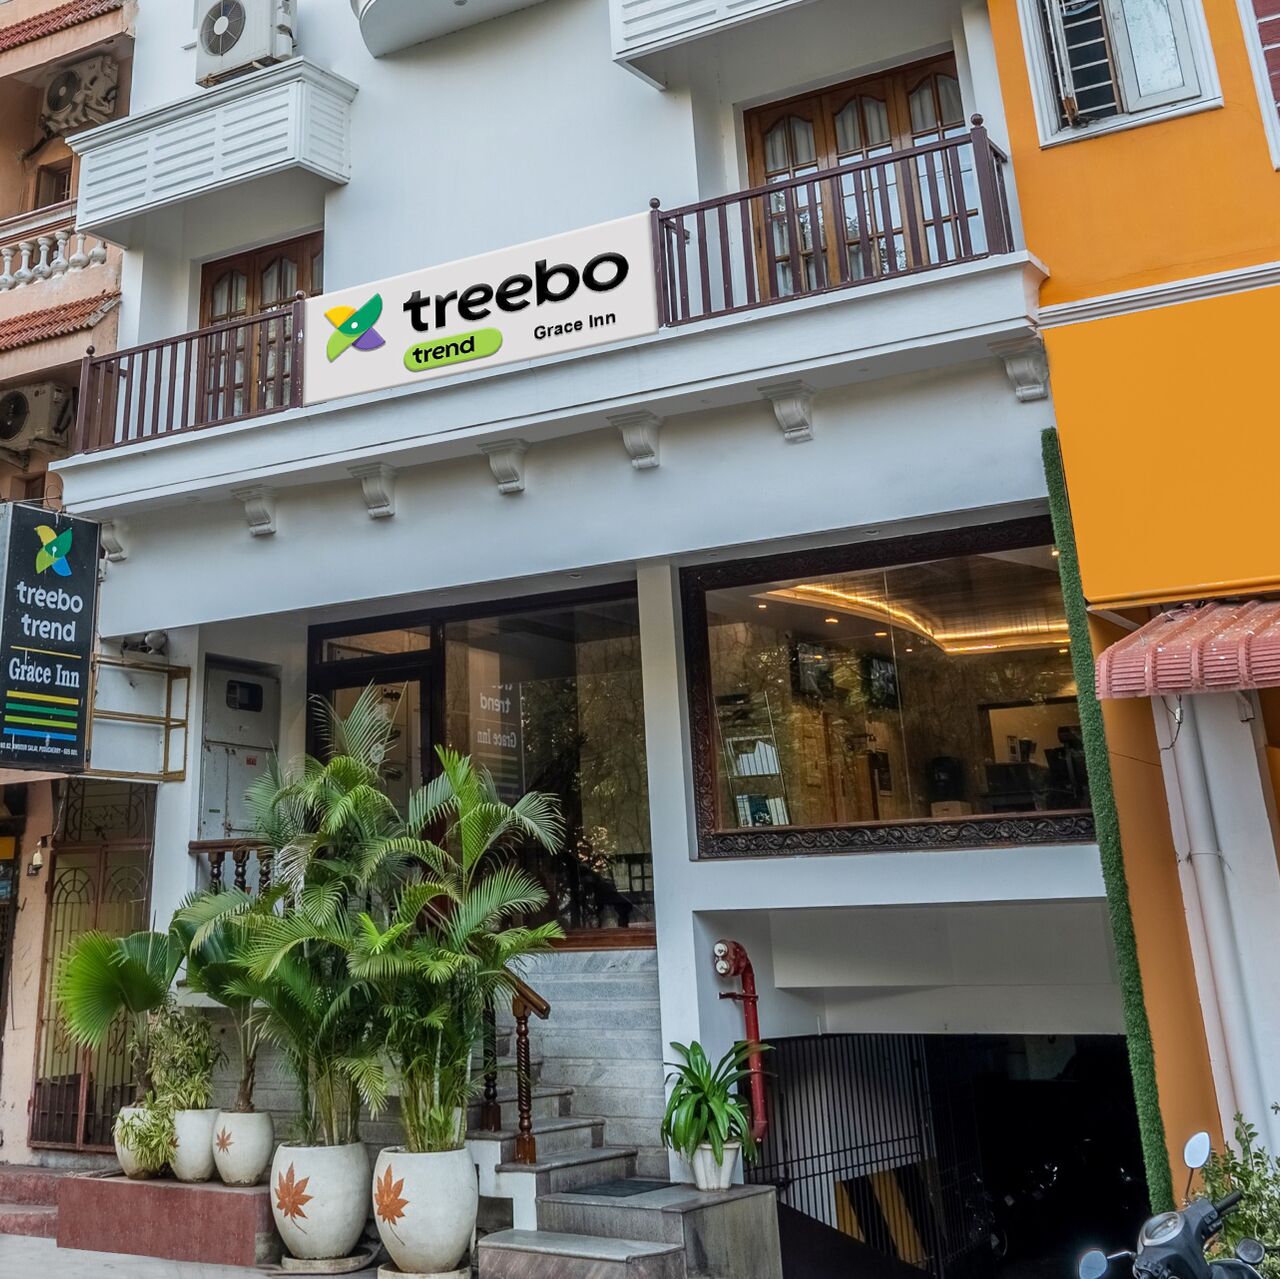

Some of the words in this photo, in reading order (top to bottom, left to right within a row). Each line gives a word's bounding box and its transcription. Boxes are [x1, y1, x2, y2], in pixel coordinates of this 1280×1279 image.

[403, 252, 629, 332] treebo
[534, 318, 583, 340] Grace
[589, 312, 617, 329] Inn
[412, 336, 475, 364] trend
[17, 580, 83, 613] treebo
[21, 613, 76, 642] trend
[9, 657, 51, 684] Grace
[55, 663, 80, 688] Inn
